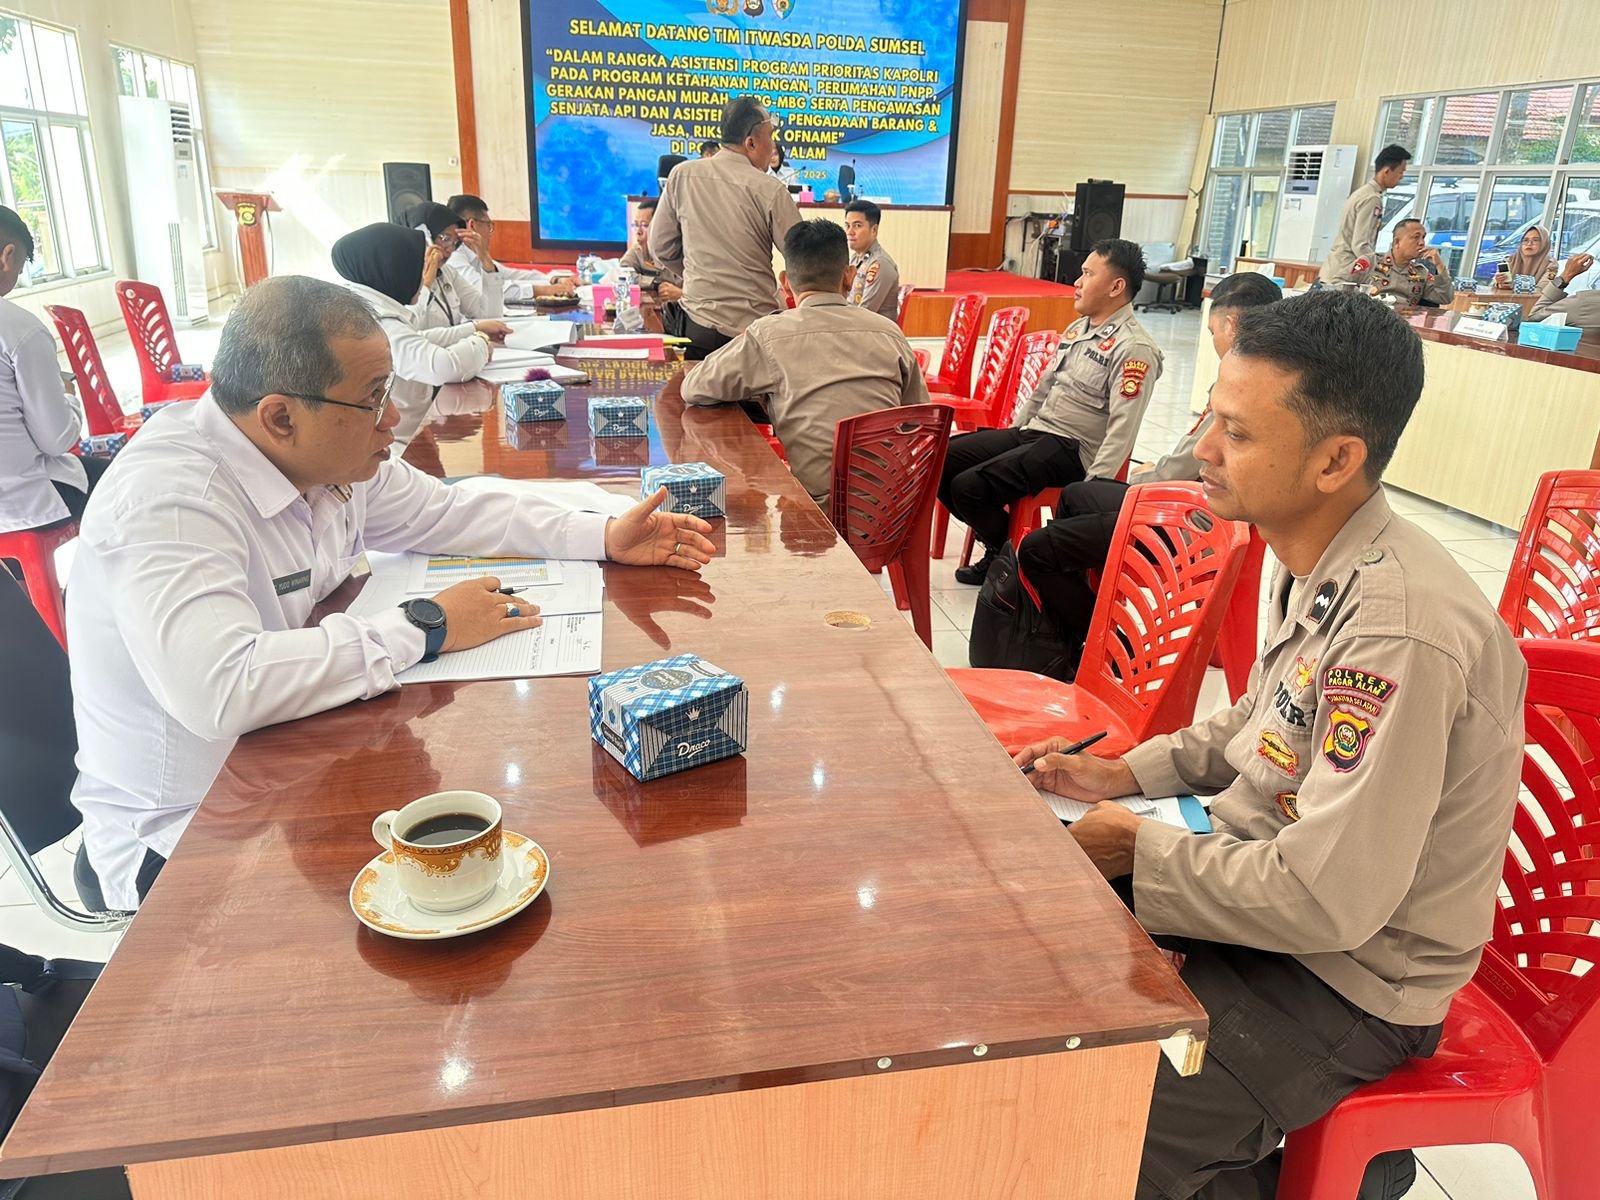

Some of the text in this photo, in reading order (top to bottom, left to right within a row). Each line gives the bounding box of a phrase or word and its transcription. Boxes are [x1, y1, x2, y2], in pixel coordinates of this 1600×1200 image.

[570, 19, 925, 55] SELAMAT DATANG TIM ITWASDA POLDA SUMSEL
[607, 52, 667, 67] RANGKA
[671, 57, 738, 71] ASISTENSI
[743, 60, 809, 75] PROGRAM
[813, 64, 879, 79] PRIORITAS
[884, 68, 939, 82] KAPOLRI
[550, 66, 936, 101] PADA PROGRAM KETAHANAN PANGAN, PERUMAHAN PNPP,
[546, 84, 615, 99] GERAKAN
[618, 87, 677, 103] PANGAN
[680, 90, 729, 105] MURAH
[810, 97, 849, 111] SERTA
[853, 99, 941, 116] PENGAWASAN
[551, 101, 610, 116] SENJATA
[614, 104, 636, 117] API
[640, 105, 669, 120] DAN
[788, 113, 868, 129] PENGADAAN
[872, 117, 924, 131] BARANG
[928, 120, 937, 132] &
[652, 123, 689, 140] JASA,
[671, 141, 684, 154] DI
[790, 147, 826, 160] ALAM
[804, 170, 826, 179] 2025
[1084, 347, 1109, 367] POLRI
[1328, 669, 1388, 690] POLRES
[1328, 677, 1382, 696] PAGAR ALAM
